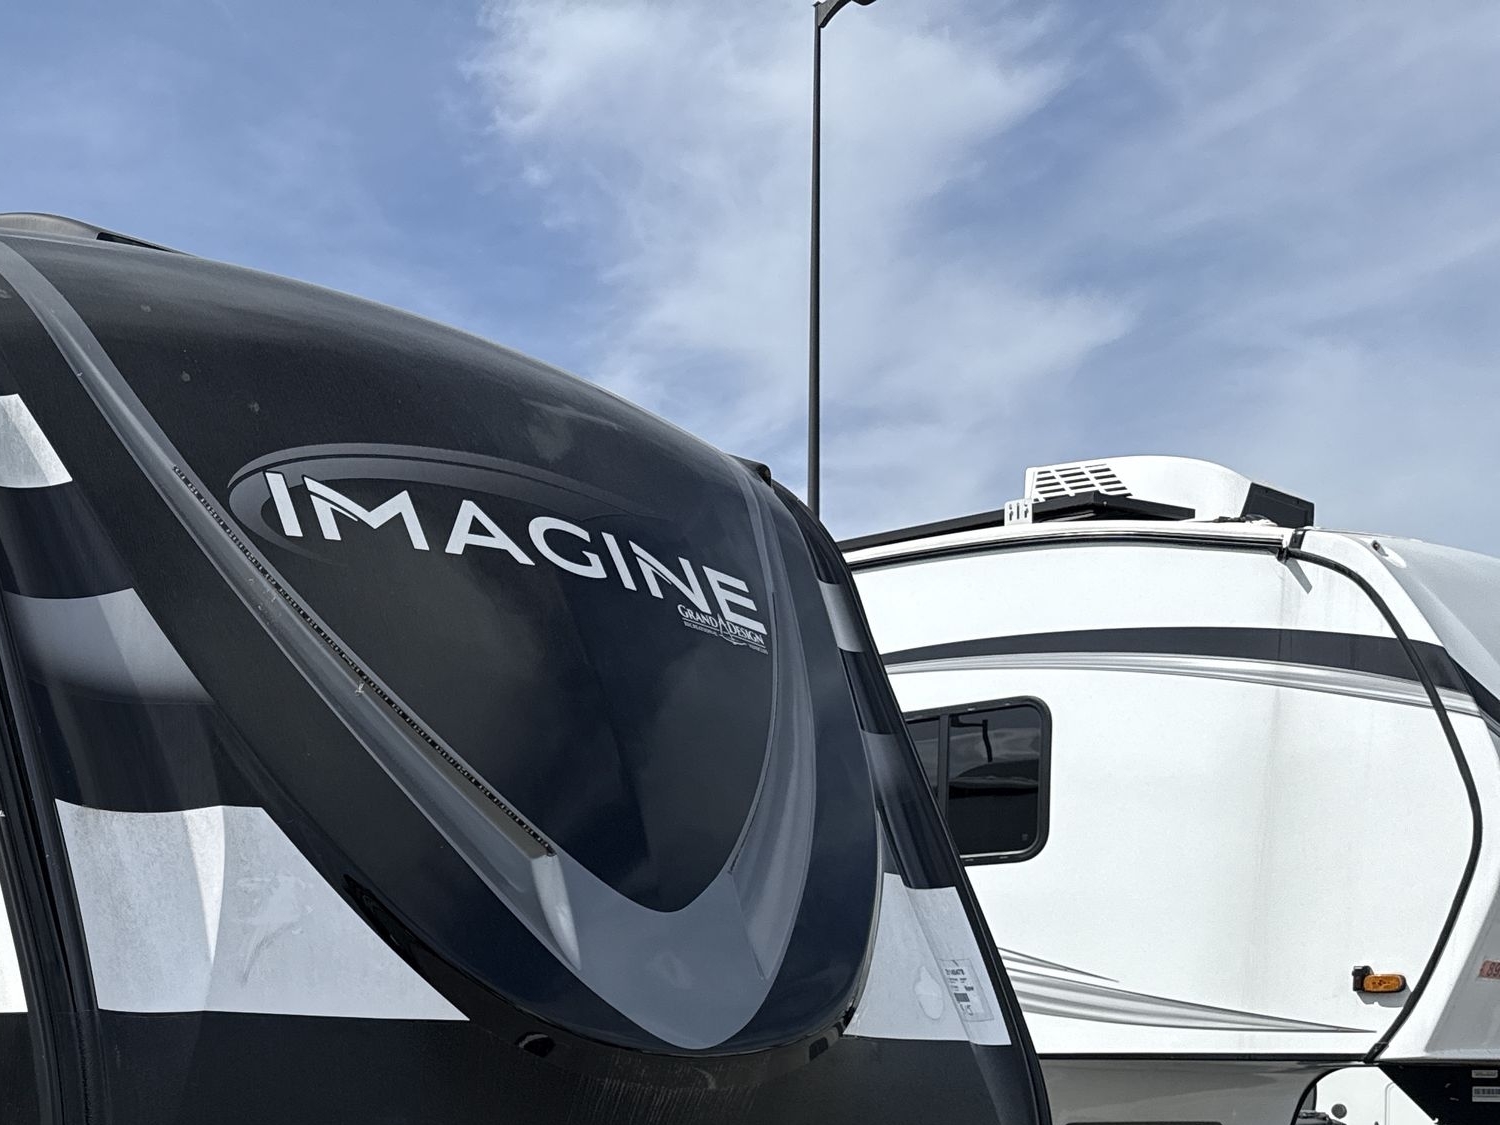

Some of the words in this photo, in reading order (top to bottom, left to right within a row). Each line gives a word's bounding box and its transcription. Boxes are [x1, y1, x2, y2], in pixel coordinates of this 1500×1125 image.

[264, 471, 768, 636] IMAGINE
[677, 604, 719, 628] GRAND
[726, 621, 765, 646] DESIGN
